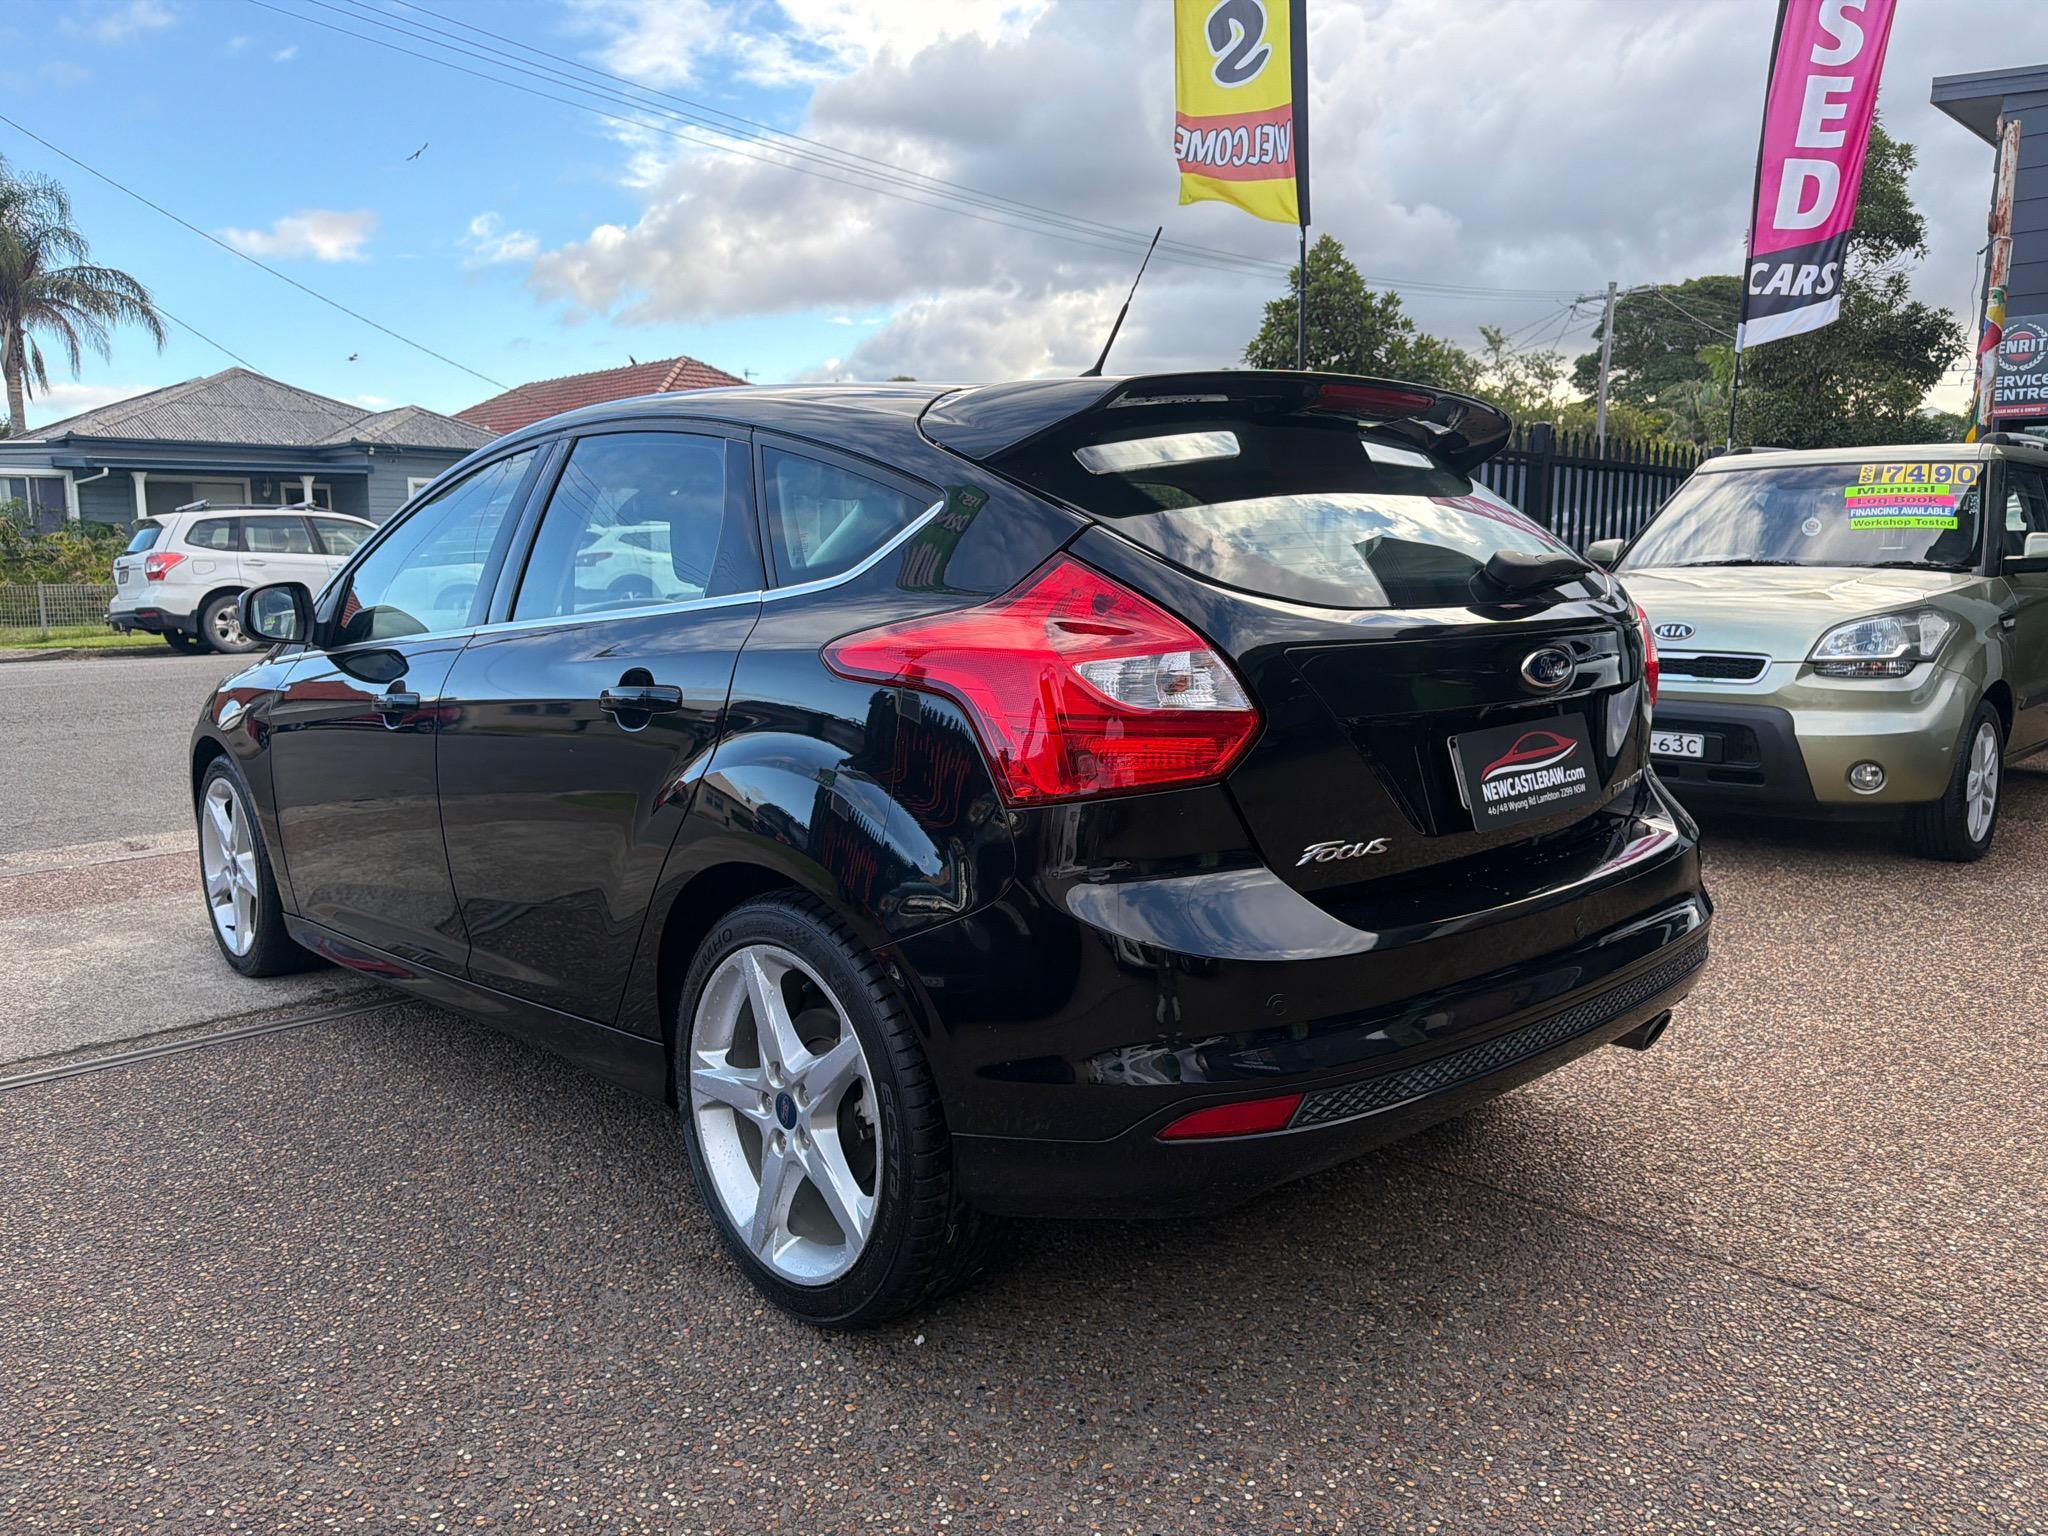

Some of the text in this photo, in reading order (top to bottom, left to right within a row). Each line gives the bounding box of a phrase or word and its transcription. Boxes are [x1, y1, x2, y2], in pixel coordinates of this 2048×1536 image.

[1748, 262, 1838, 297] CARS
[1999, 338, 2048, 354] ENRIT
[1996, 373, 2048, 388] ERVICE
[1994, 387, 2048, 402] ENTRE
[1857, 485, 1936, 495] Manual
[1857, 495, 1939, 505] Log Book
[1850, 506, 1951, 517] FINANCING AVAILABLE
[1853, 518, 1955, 527] Workshop Tested
[1659, 625, 1687, 636] KIA
[1482, 766, 1586, 802] NEWCASTLERAW.com
[1488, 783, 1586, 816] 46/48 Wyong Rd Lambton 2299 NSW
